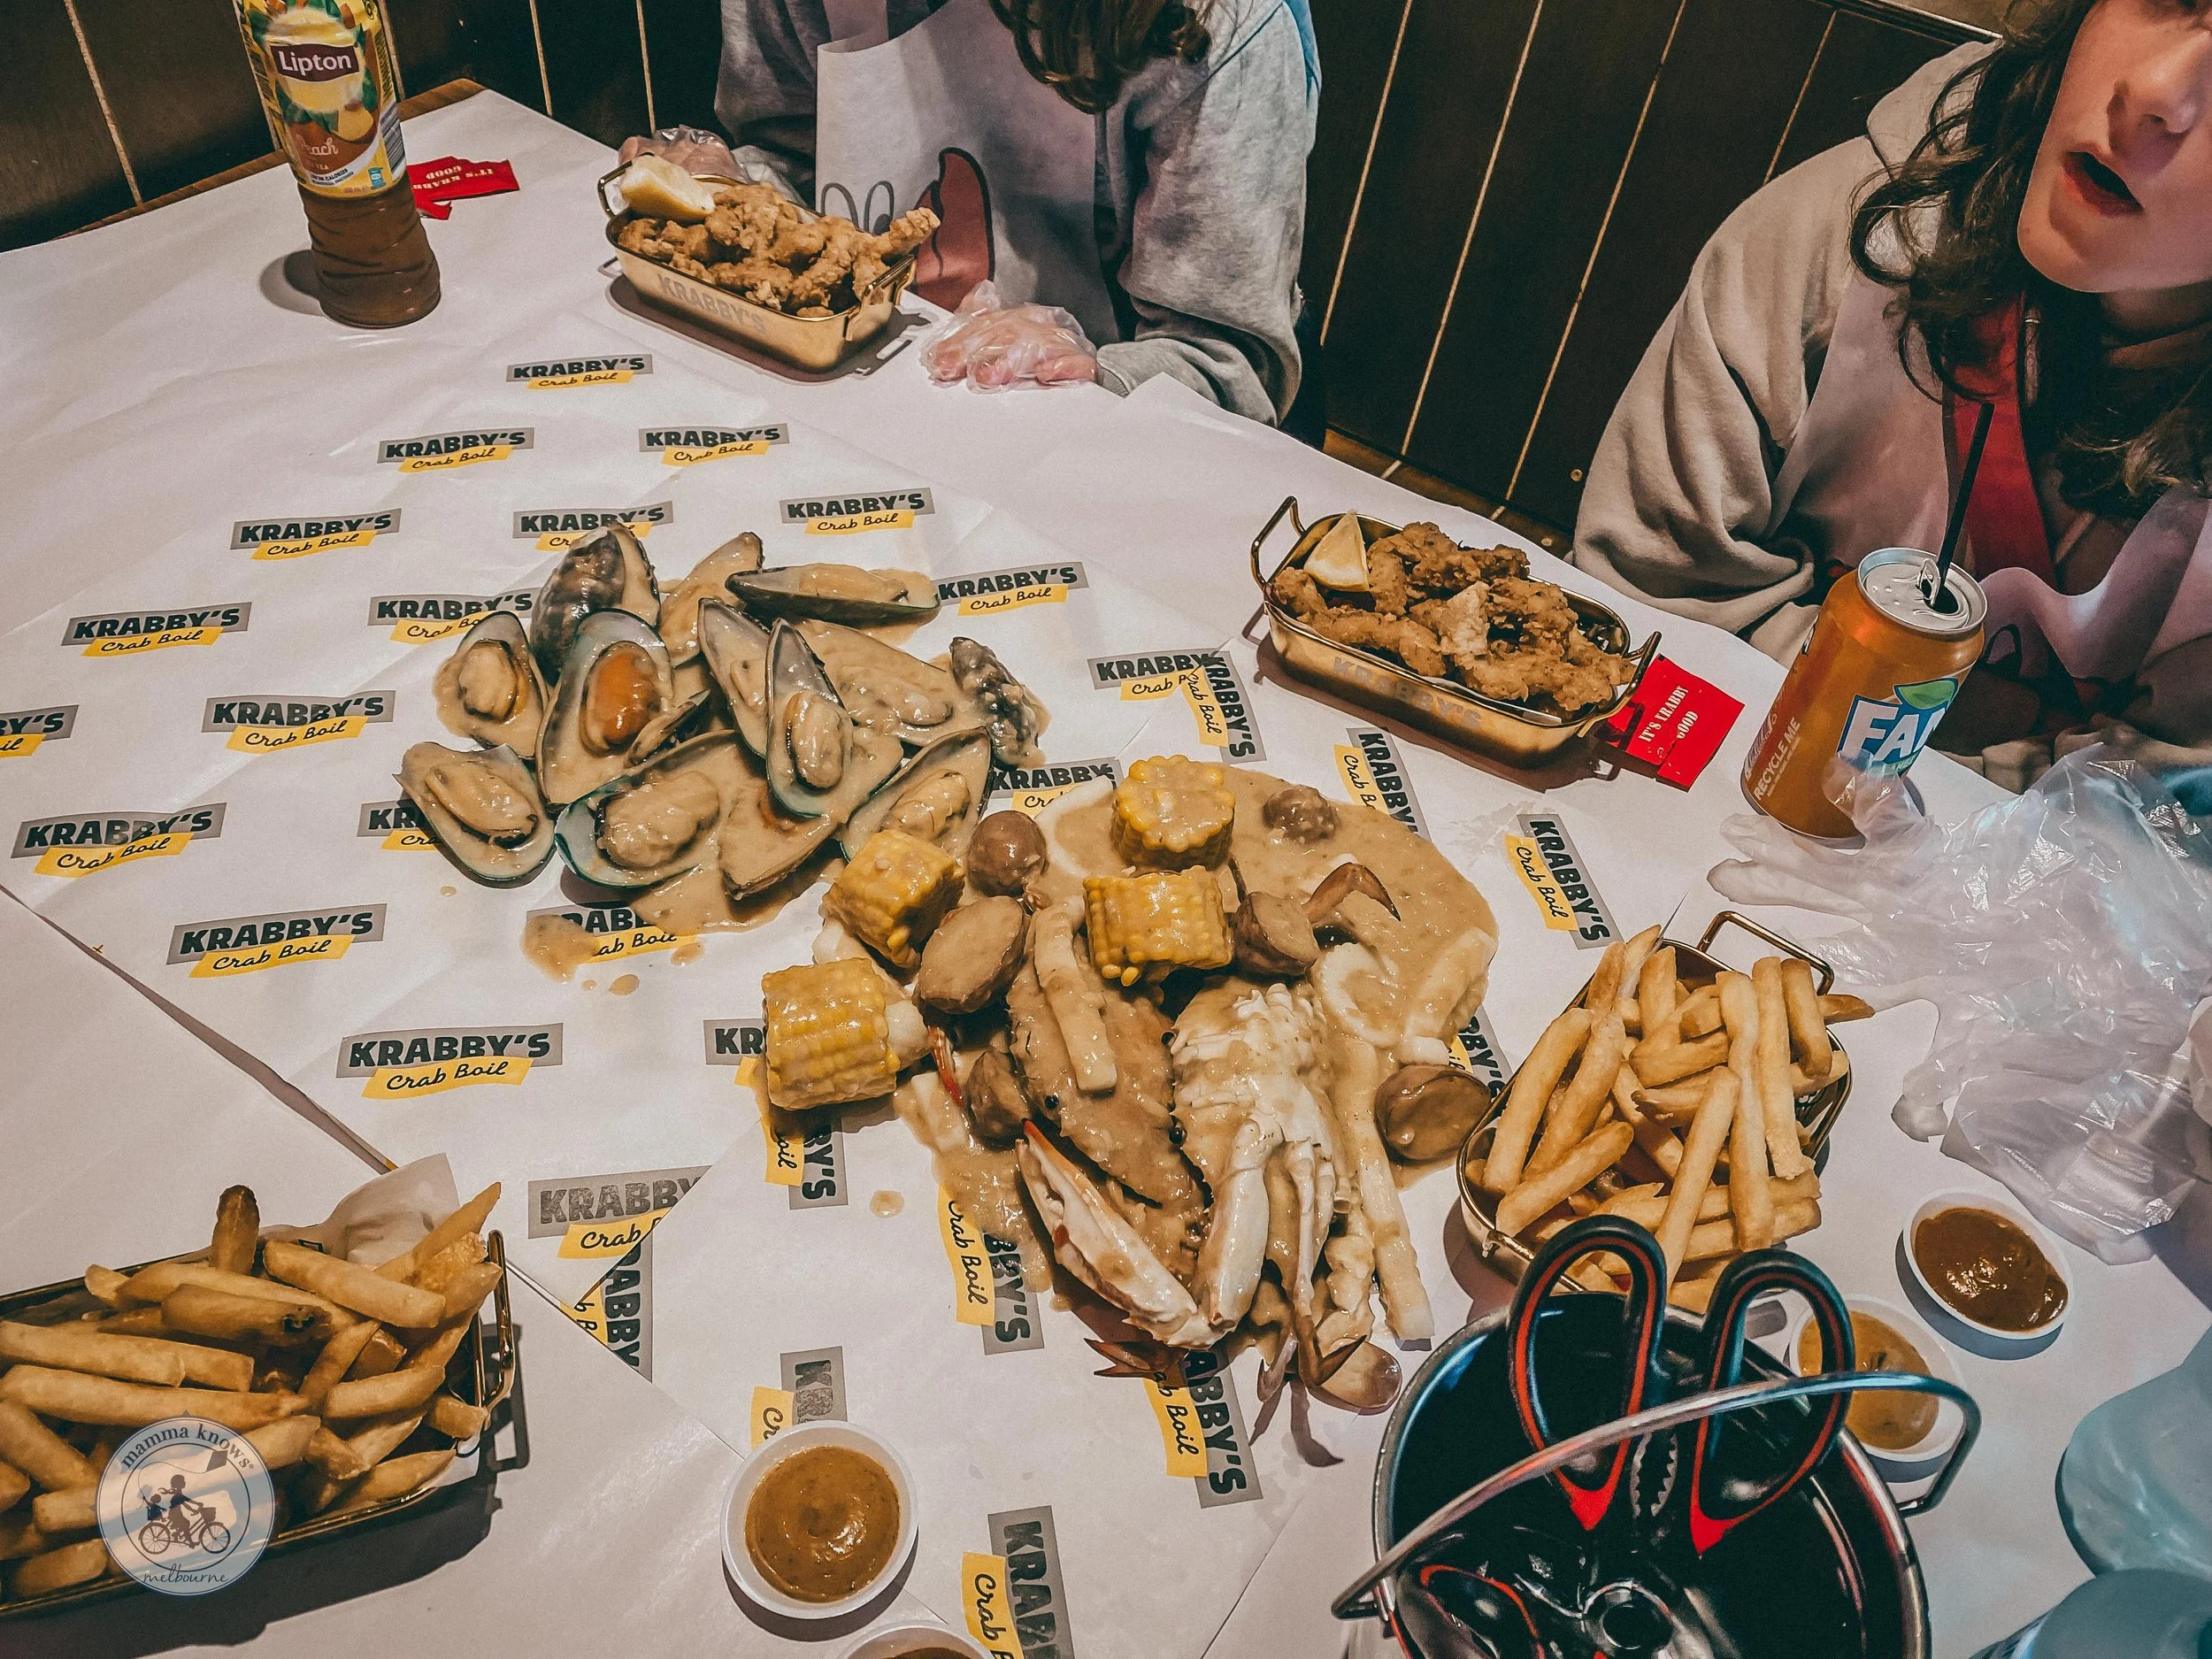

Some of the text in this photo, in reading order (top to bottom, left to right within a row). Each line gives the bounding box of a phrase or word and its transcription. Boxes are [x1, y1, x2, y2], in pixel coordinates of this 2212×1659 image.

[278, 50, 352, 76] Lipton
[426, 165, 462, 180] GOOD
[657, 273, 767, 334] KRABBY'S
[513, 357, 645, 379] KRABBY'S
[538, 372, 618, 388] Crab Boil
[385, 430, 526, 458] KRABBY'S
[645, 428, 780, 448] KRABBY'S
[673, 442, 754, 462] Crab Boil
[411, 446, 495, 469] Crab Boil
[787, 493, 926, 518] KRABBY'S
[240, 514, 391, 543] KRABBY'S
[817, 512, 899, 531] Crab Boil
[267, 533, 359, 556] Crab Boil
[938, 566, 1078, 601] KRABBY'S
[377, 593, 533, 619] KRABBY'S
[970, 587, 1051, 611] Crab Boil
[73, 608, 240, 639] KRABBY'S
[407, 625, 453, 638] Crab
[100, 629, 204, 652] Crab Boil
[1132, 673, 1173, 695] Crab
[1333, 656, 1483, 729] KRABBY'S
[211, 695, 384, 726] KRABBY'S
[1199, 704, 1222, 733] Boil
[244, 718, 349, 749] Crab Boil
[1344, 755, 1369, 788] Crab
[1753, 740, 1787, 801] RECYCLE
[1783, 717, 1801, 743] ME
[24, 810, 212, 849] KRABBY'S
[57, 836, 172, 871] Crab Boil
[1516, 846, 1569, 918] Crab Boil
[1530, 820, 1610, 941] KRABBY'S
[179, 912, 373, 955] KRABBY'S
[212, 939, 332, 971] Crab Boil
[349, 1033, 550, 1067] KRABBY'S
[386, 1060, 509, 1091] Crab Boil
[580, 1223, 641, 1249] Crab
[961, 1255, 988, 1305] Boil
[1165, 1404, 1200, 1455] Boil
[974, 1572, 1007, 1641] Crab
